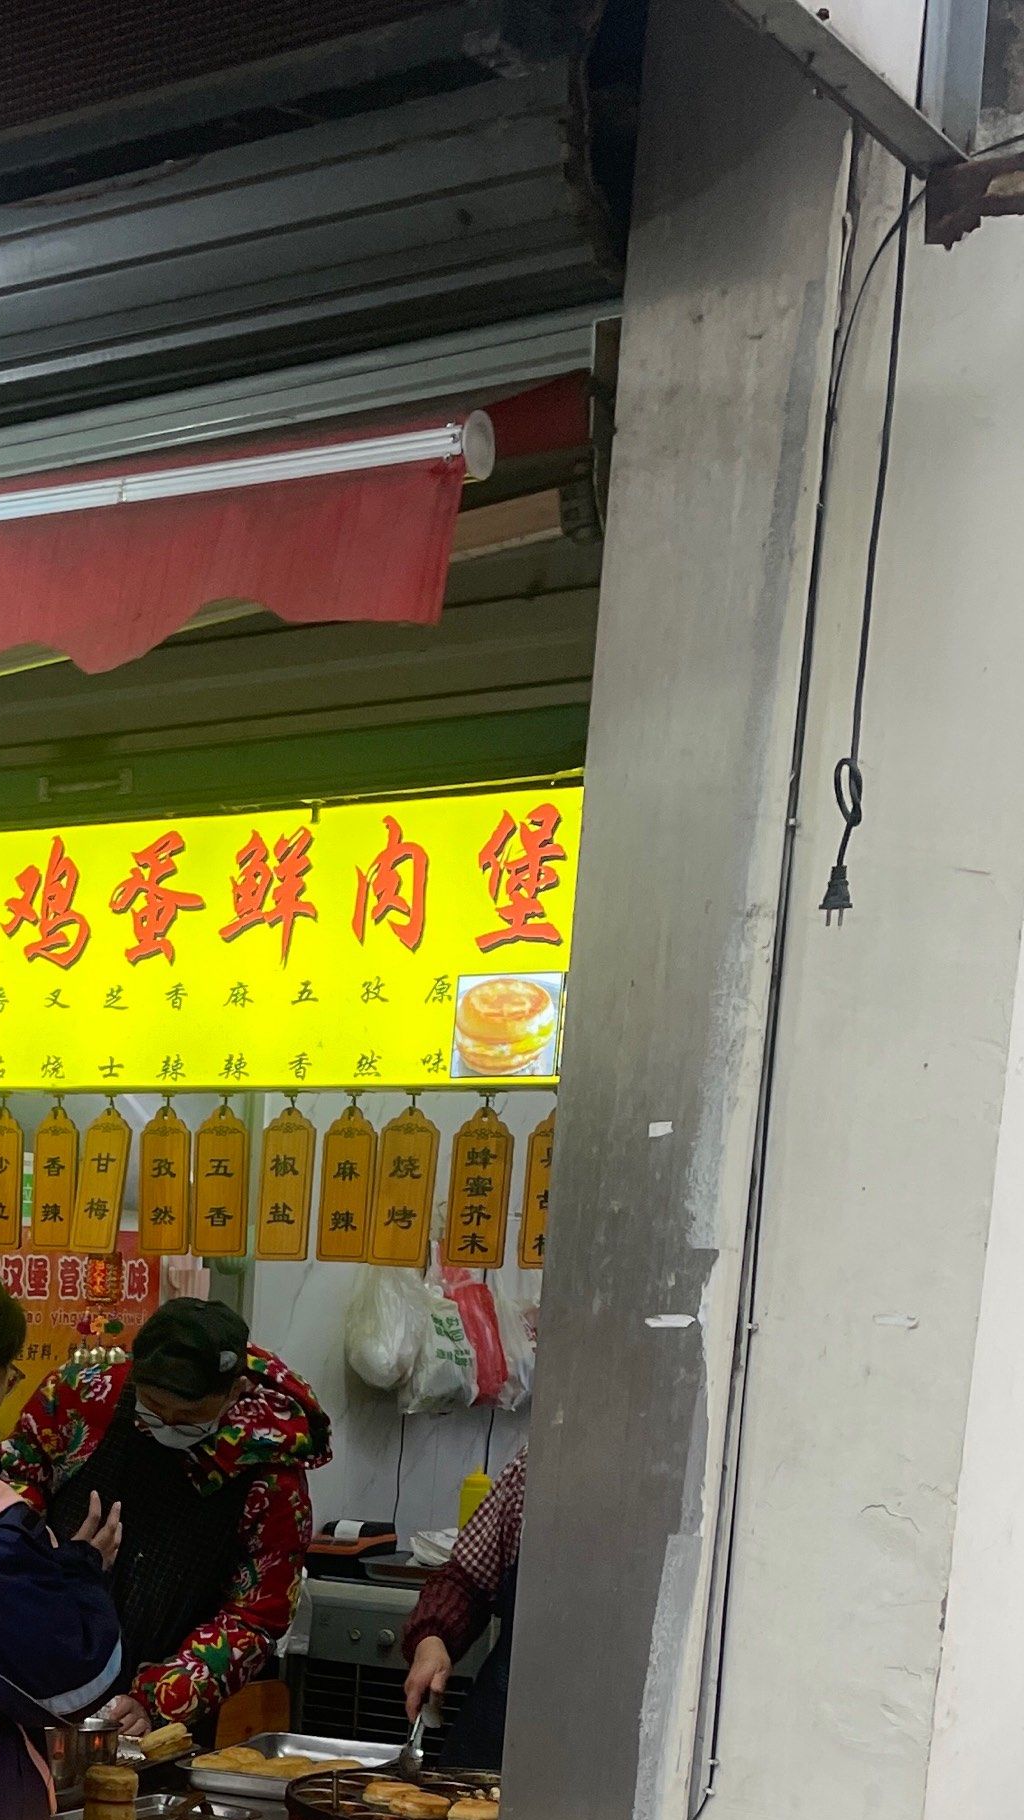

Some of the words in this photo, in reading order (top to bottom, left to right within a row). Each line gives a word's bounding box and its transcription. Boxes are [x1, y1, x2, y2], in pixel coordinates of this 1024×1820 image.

[41, 988, 71, 1080] 叉烧
[98, 985, 129, 1078] 芝士
[156, 982, 188, 1081] 香辣
[219, 982, 254, 1081] 麻辣
[288, 980, 319, 1080] 五香
[353, 976, 389, 1078] 孜然
[421, 974, 453, 1074] 原味
[41, 1156, 65, 1223] 香辣
[84, 1152, 116, 1221] 甘梅
[150, 1158, 176, 1226] 孜然
[205, 1158, 233, 1227] 五香
[266, 1154, 299, 1225] 椒盐
[329, 1160, 360, 1232] 麻辣
[384, 1156, 421, 1230] 烧烤
[458, 1147, 497, 1255] 蜂蜜芥末
[59, 1254, 149, 1301] 营味
